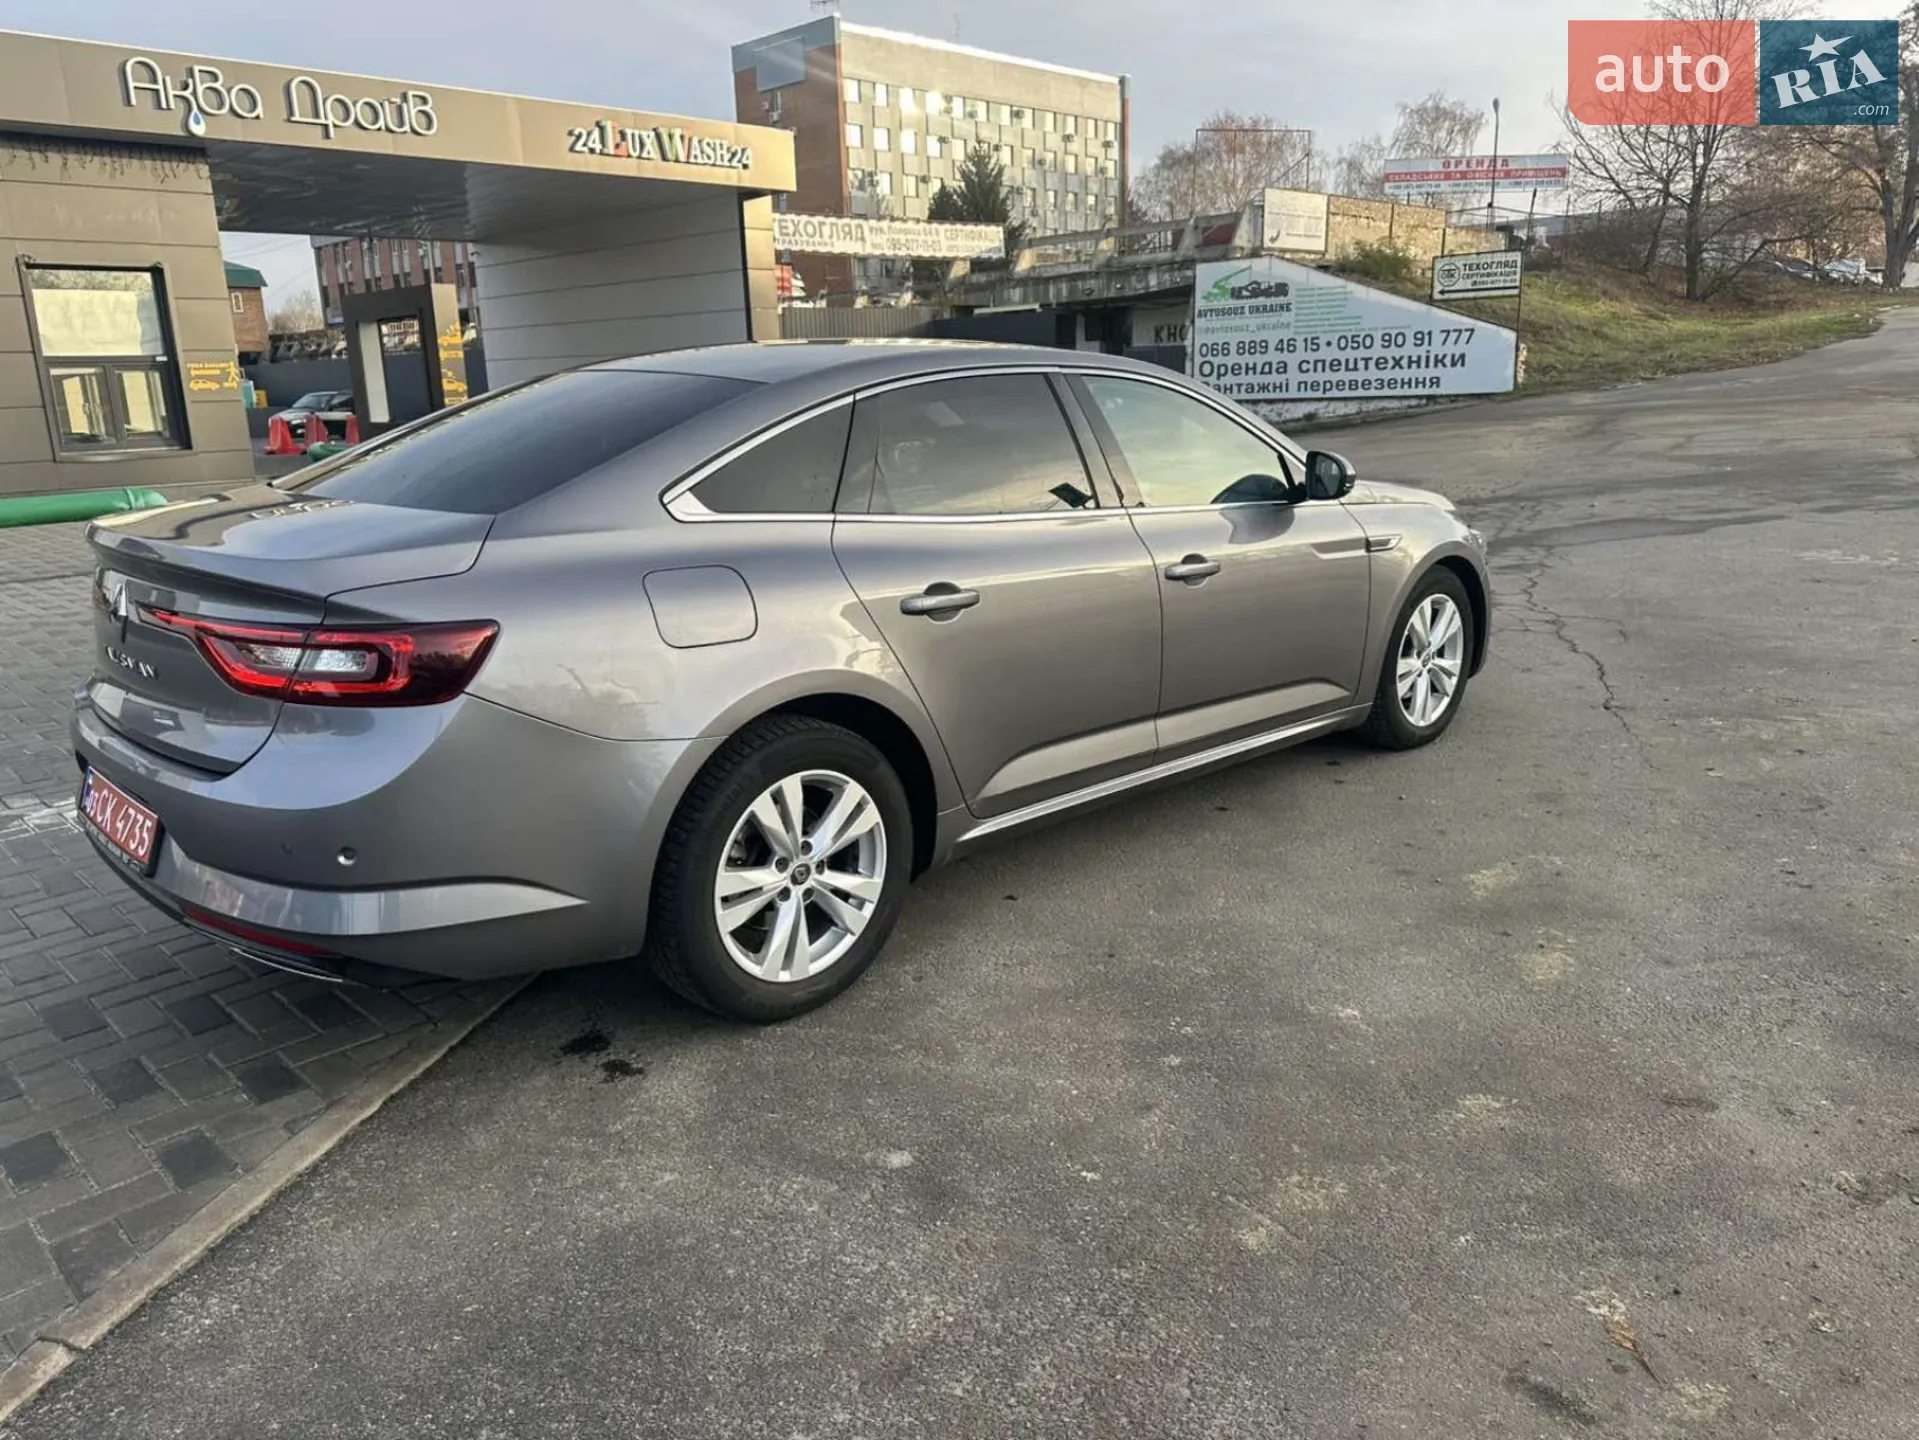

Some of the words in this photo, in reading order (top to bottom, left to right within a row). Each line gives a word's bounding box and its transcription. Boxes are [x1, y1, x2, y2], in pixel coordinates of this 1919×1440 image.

[1442, 158, 1510, 169] ОРЕНДА
[774, 218, 866, 244] ЕХОГЛЯД
[1463, 260, 1518, 272] ТЕХОГЛЯД
[1248, 302, 1292, 315] UKRAINE
[1200, 342, 1231, 358] 066
[1236, 340, 1268, 356] 889
[1275, 338, 1297, 354] 46
[1303, 336, 1320, 352] 15
[1337, 333, 1375, 351] 050
[1381, 331, 1406, 348] 90
[1412, 330, 1432, 347] 91
[1439, 328, 1475, 347] 777
[1199, 360, 1288, 381] Оренда
[1298, 350, 1467, 374] спецтехніки
[1297, 376, 1441, 394] перевезення
[116, 804, 152, 856] 4735
